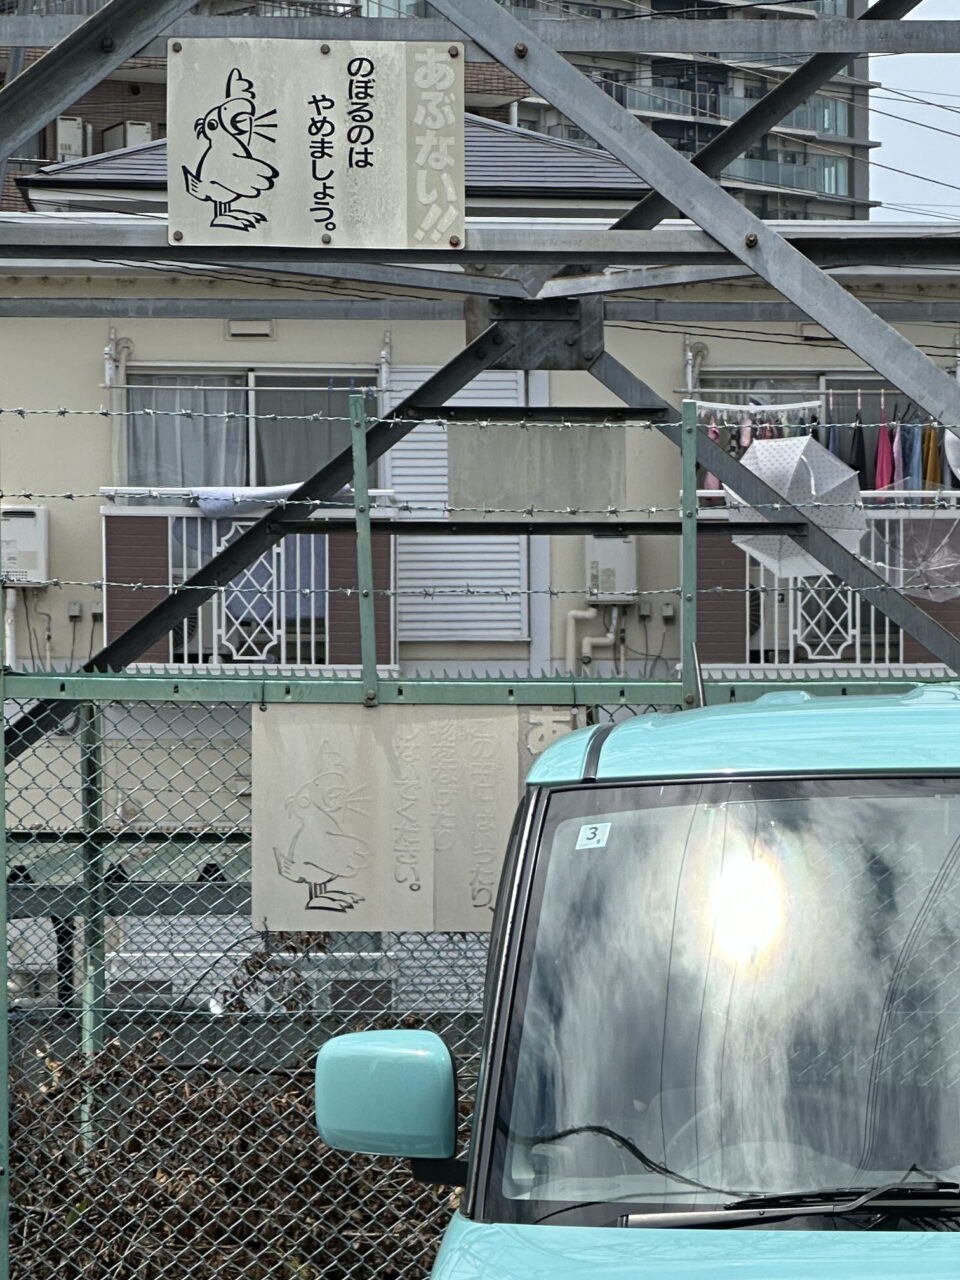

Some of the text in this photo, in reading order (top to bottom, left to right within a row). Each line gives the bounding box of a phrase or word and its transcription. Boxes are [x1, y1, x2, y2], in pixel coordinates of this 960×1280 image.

[307, 94, 337, 231] やめましょう。
[347, 56, 375, 169] のぼるのは
